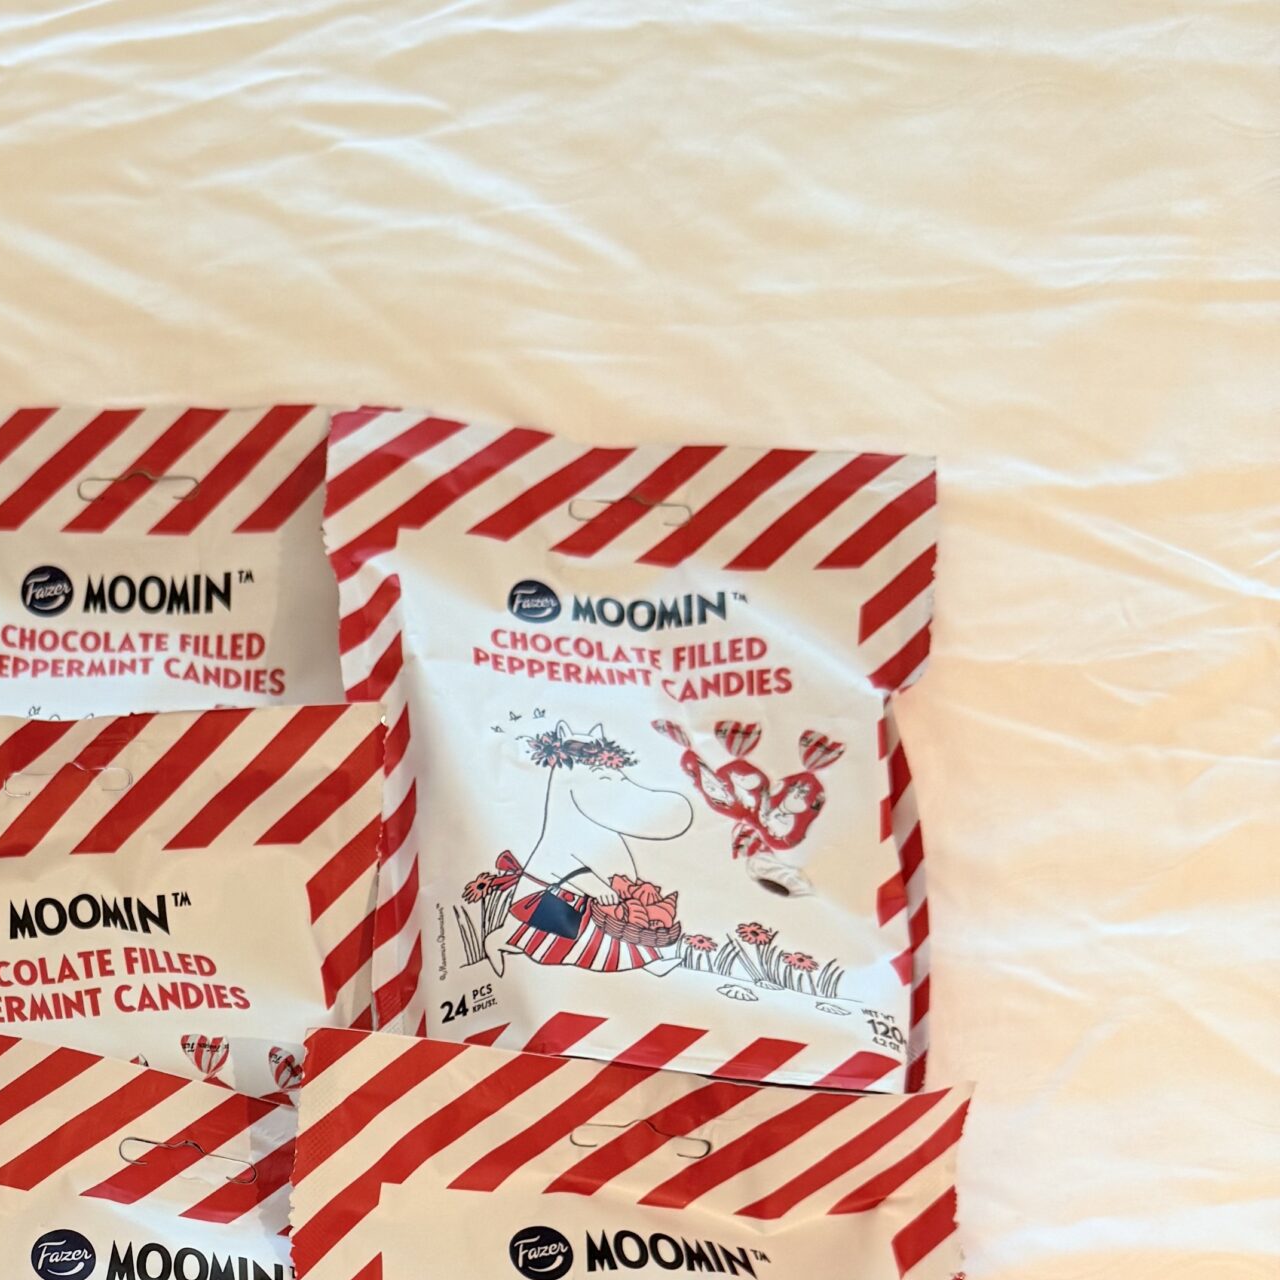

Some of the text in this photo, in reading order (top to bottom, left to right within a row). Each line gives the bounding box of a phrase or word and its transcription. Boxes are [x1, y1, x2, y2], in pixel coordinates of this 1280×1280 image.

[1, 625, 265, 660] CHOCOLATE FILLED
[491, 629, 767, 672] CHOCOLATE FILLED
[164, 658, 285, 696] CANDIES
[473, 647, 652, 686] PEPPERMINT
[123, 947, 217, 977] FILLED
[114, 981, 251, 1013] CANDIES
[472, 983, 493, 1000] PCS
[439, 994, 469, 1024] 24
[867, 1018, 907, 1046] 120
